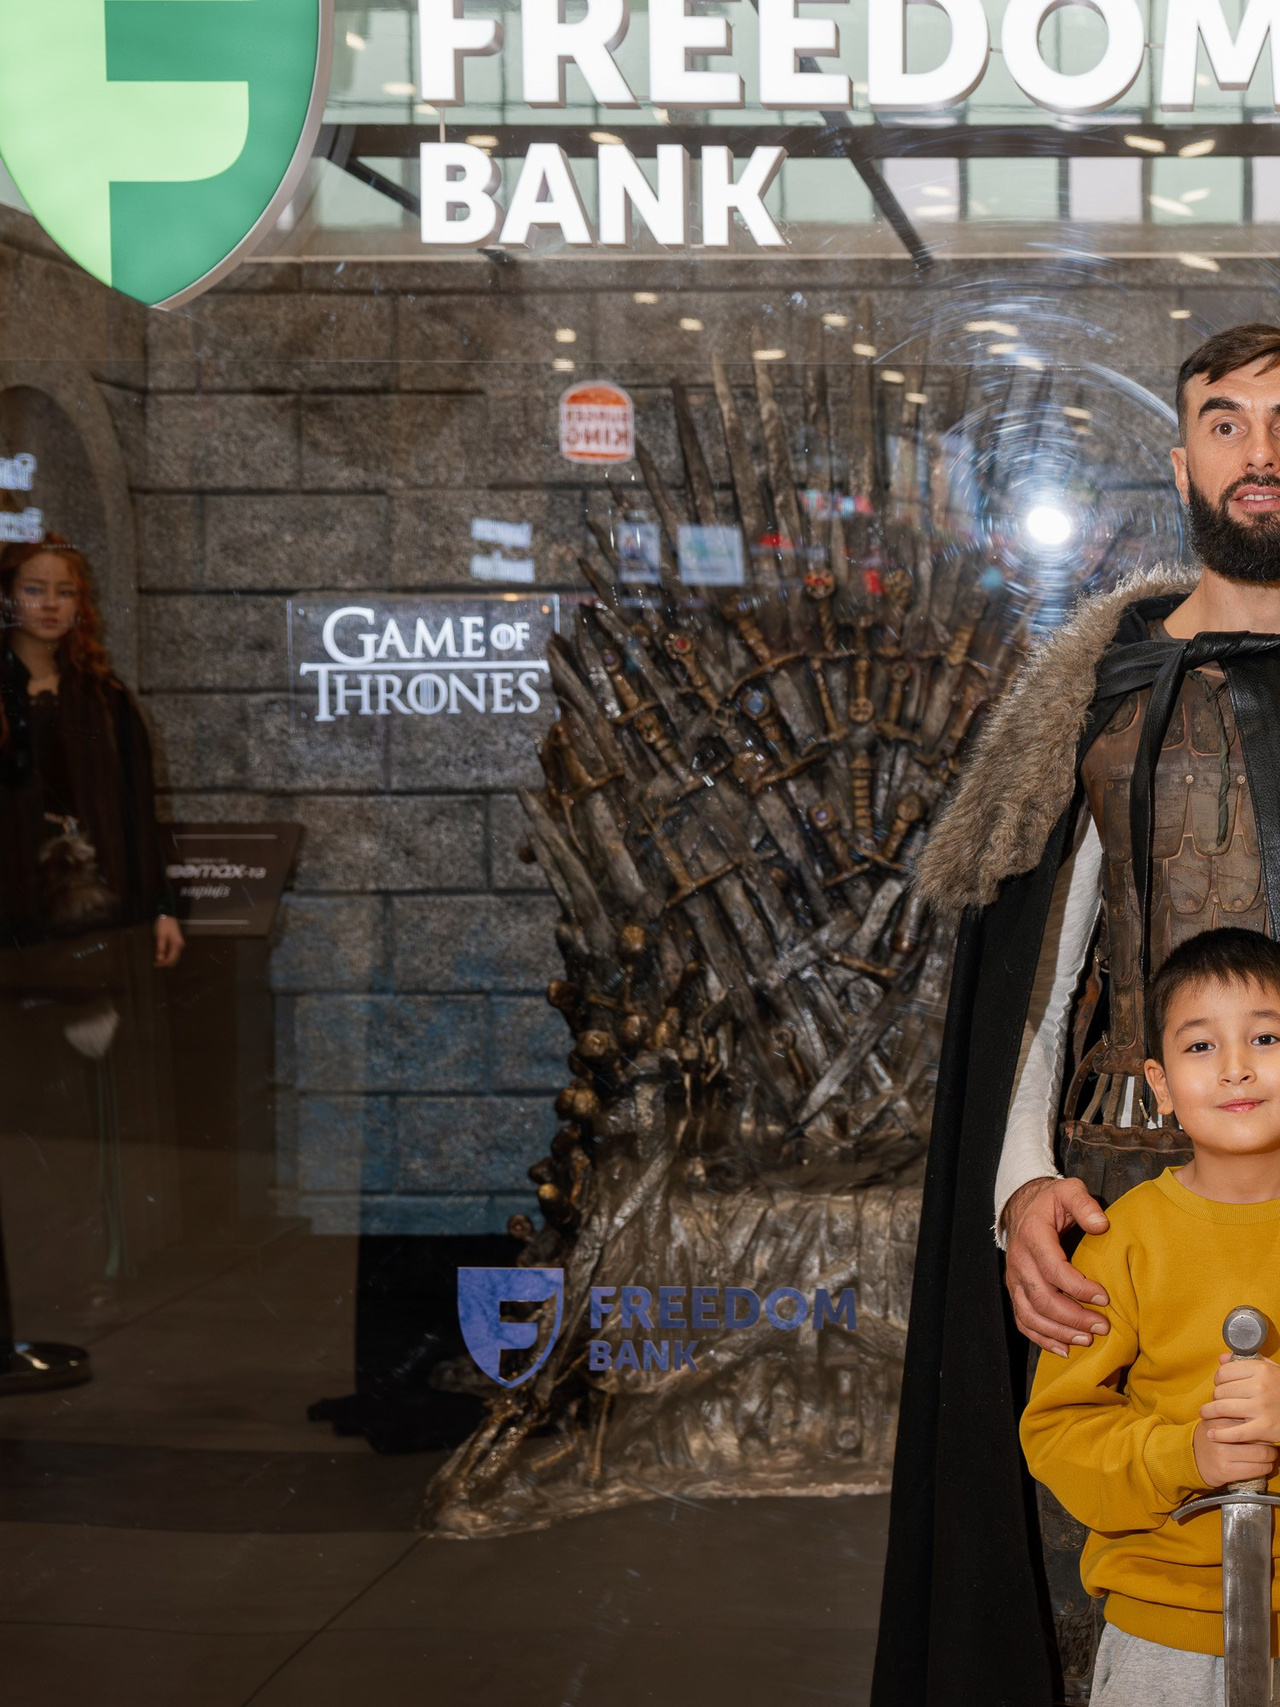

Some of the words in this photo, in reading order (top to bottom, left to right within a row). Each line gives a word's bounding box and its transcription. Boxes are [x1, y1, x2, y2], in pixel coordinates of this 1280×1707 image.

[419, 142, 788, 249] BANK
[322, 606, 486, 665] GAME
[490, 622, 530, 650] OF
[300, 660, 549, 722] THRONES
[589, 1286, 857, 1331] FREEDOM
[589, 1340, 699, 1371] BANK
